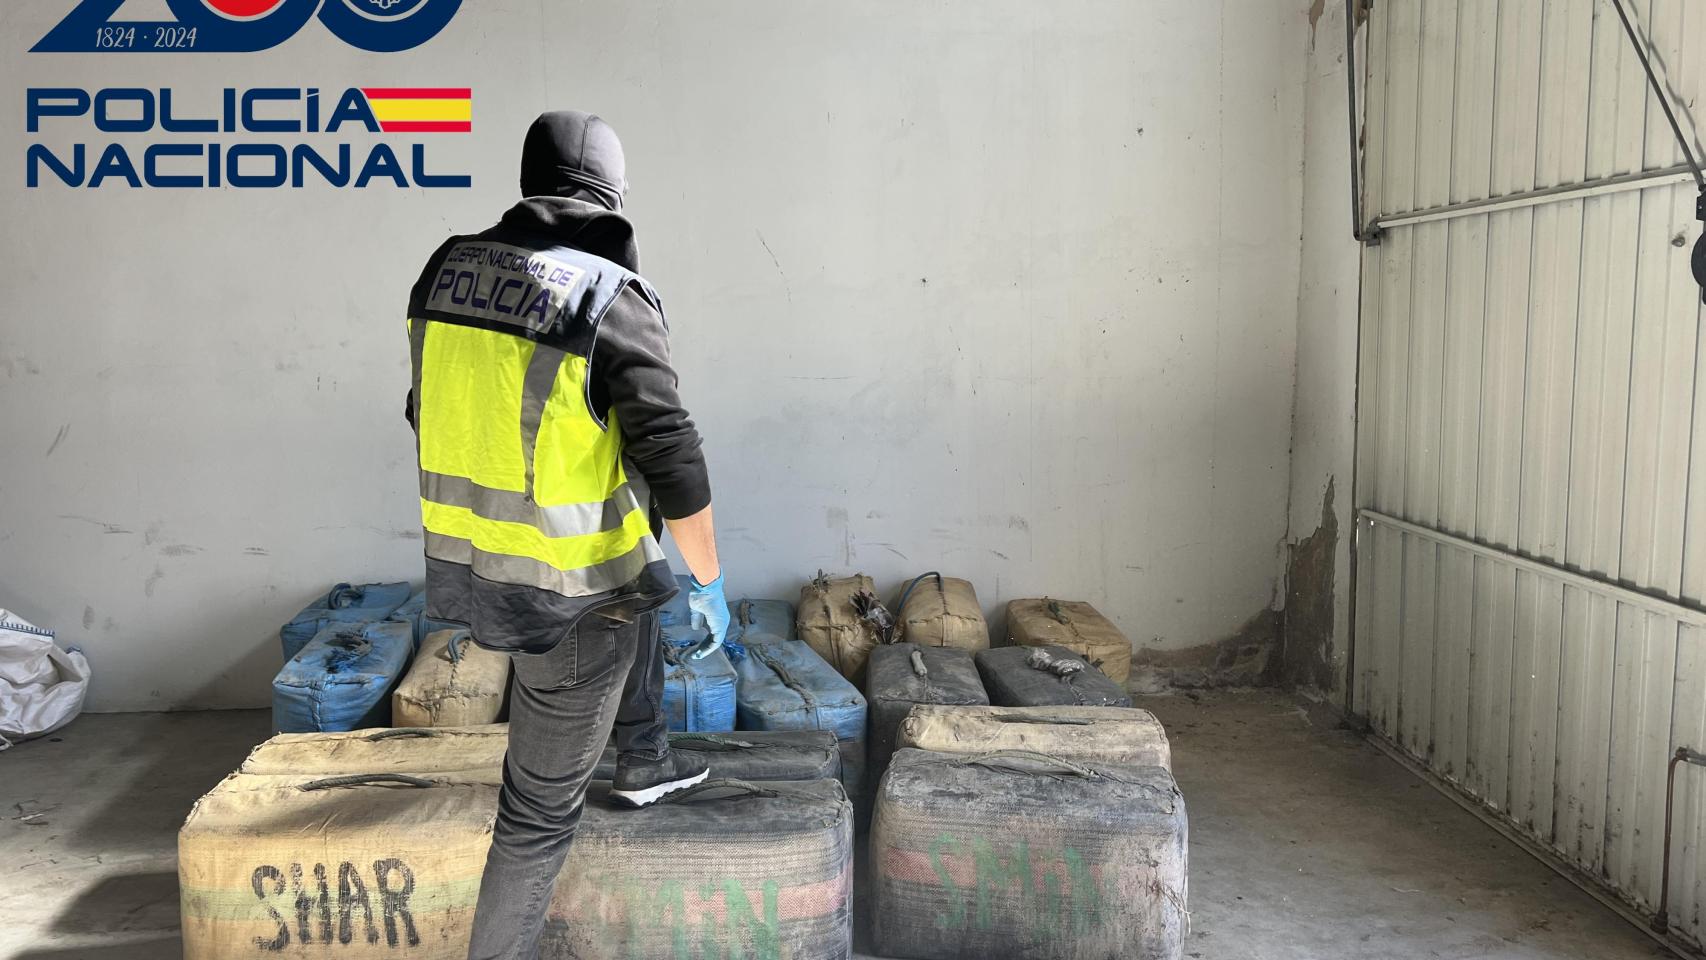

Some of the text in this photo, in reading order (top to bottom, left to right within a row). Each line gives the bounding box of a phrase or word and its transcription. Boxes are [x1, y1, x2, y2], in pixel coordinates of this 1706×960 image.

[486, 249, 546, 279] NACIONAL
[548, 267, 573, 286] DE
[432, 268, 551, 324] POLICIA
[251, 857, 420, 951] SHAR
